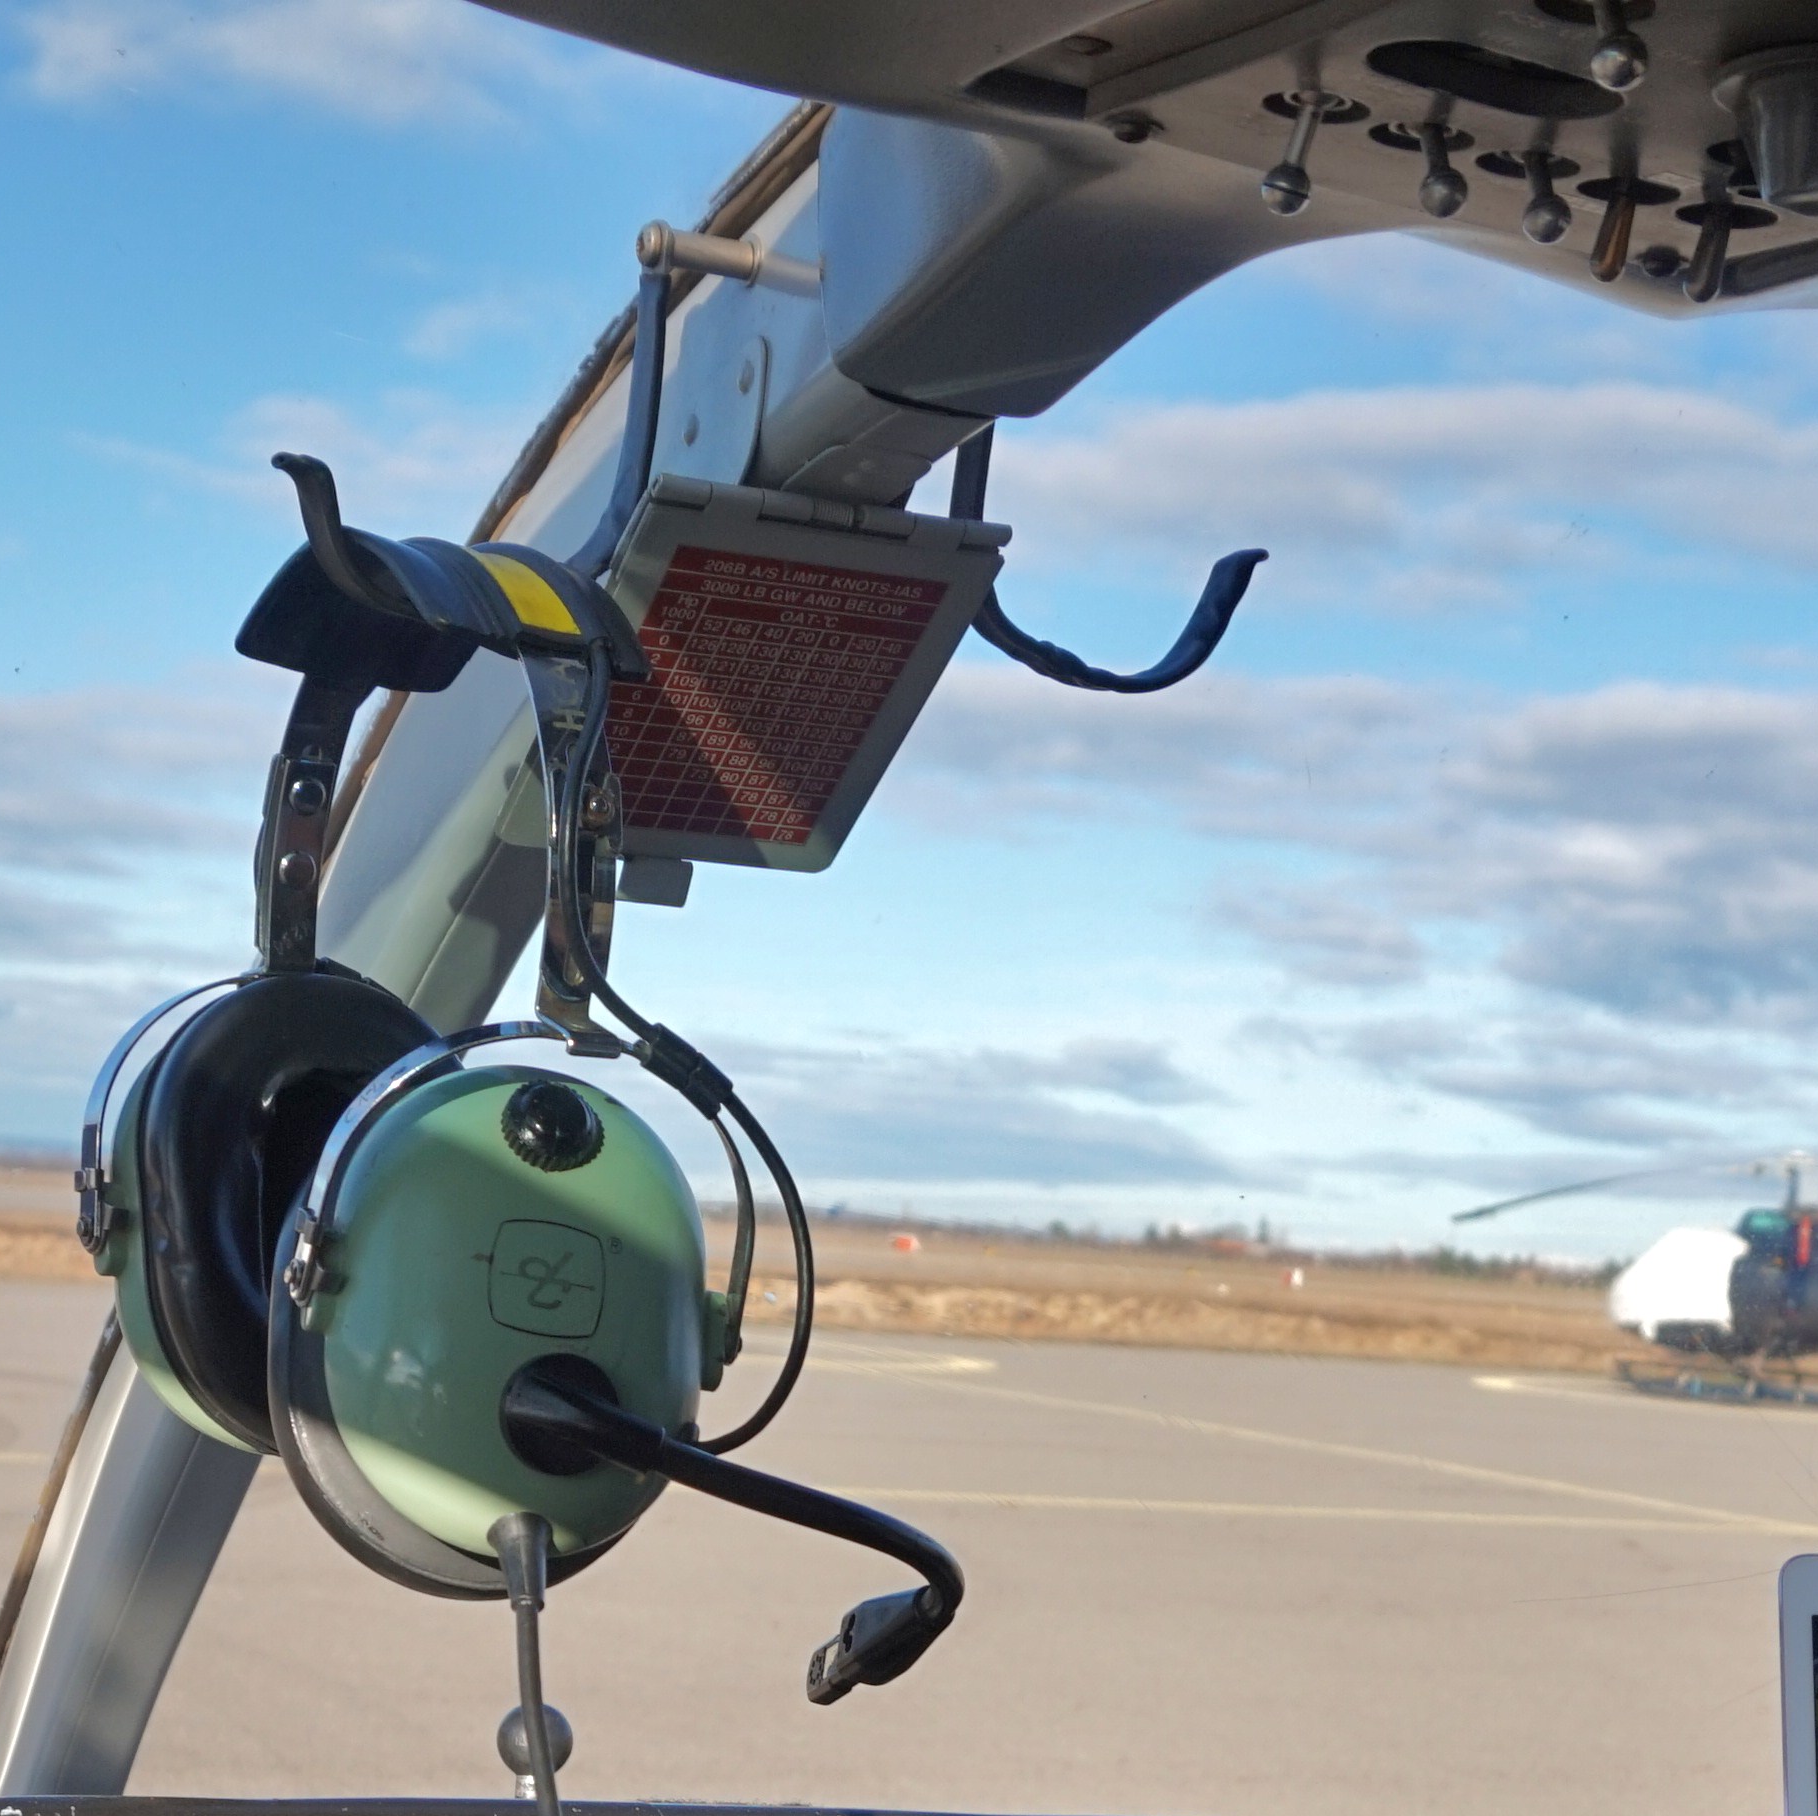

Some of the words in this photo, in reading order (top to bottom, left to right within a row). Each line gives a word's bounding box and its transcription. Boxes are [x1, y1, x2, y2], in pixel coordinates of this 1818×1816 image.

[704, 560, 746, 575] 206B
[782, 568, 829, 586] LIMIT
[701, 580, 741, 595] 3000
[744, 585, 766, 598] LB
[770, 587, 799, 602] GW
[807, 593, 841, 608] AND
[845, 598, 907, 616] BELOW
